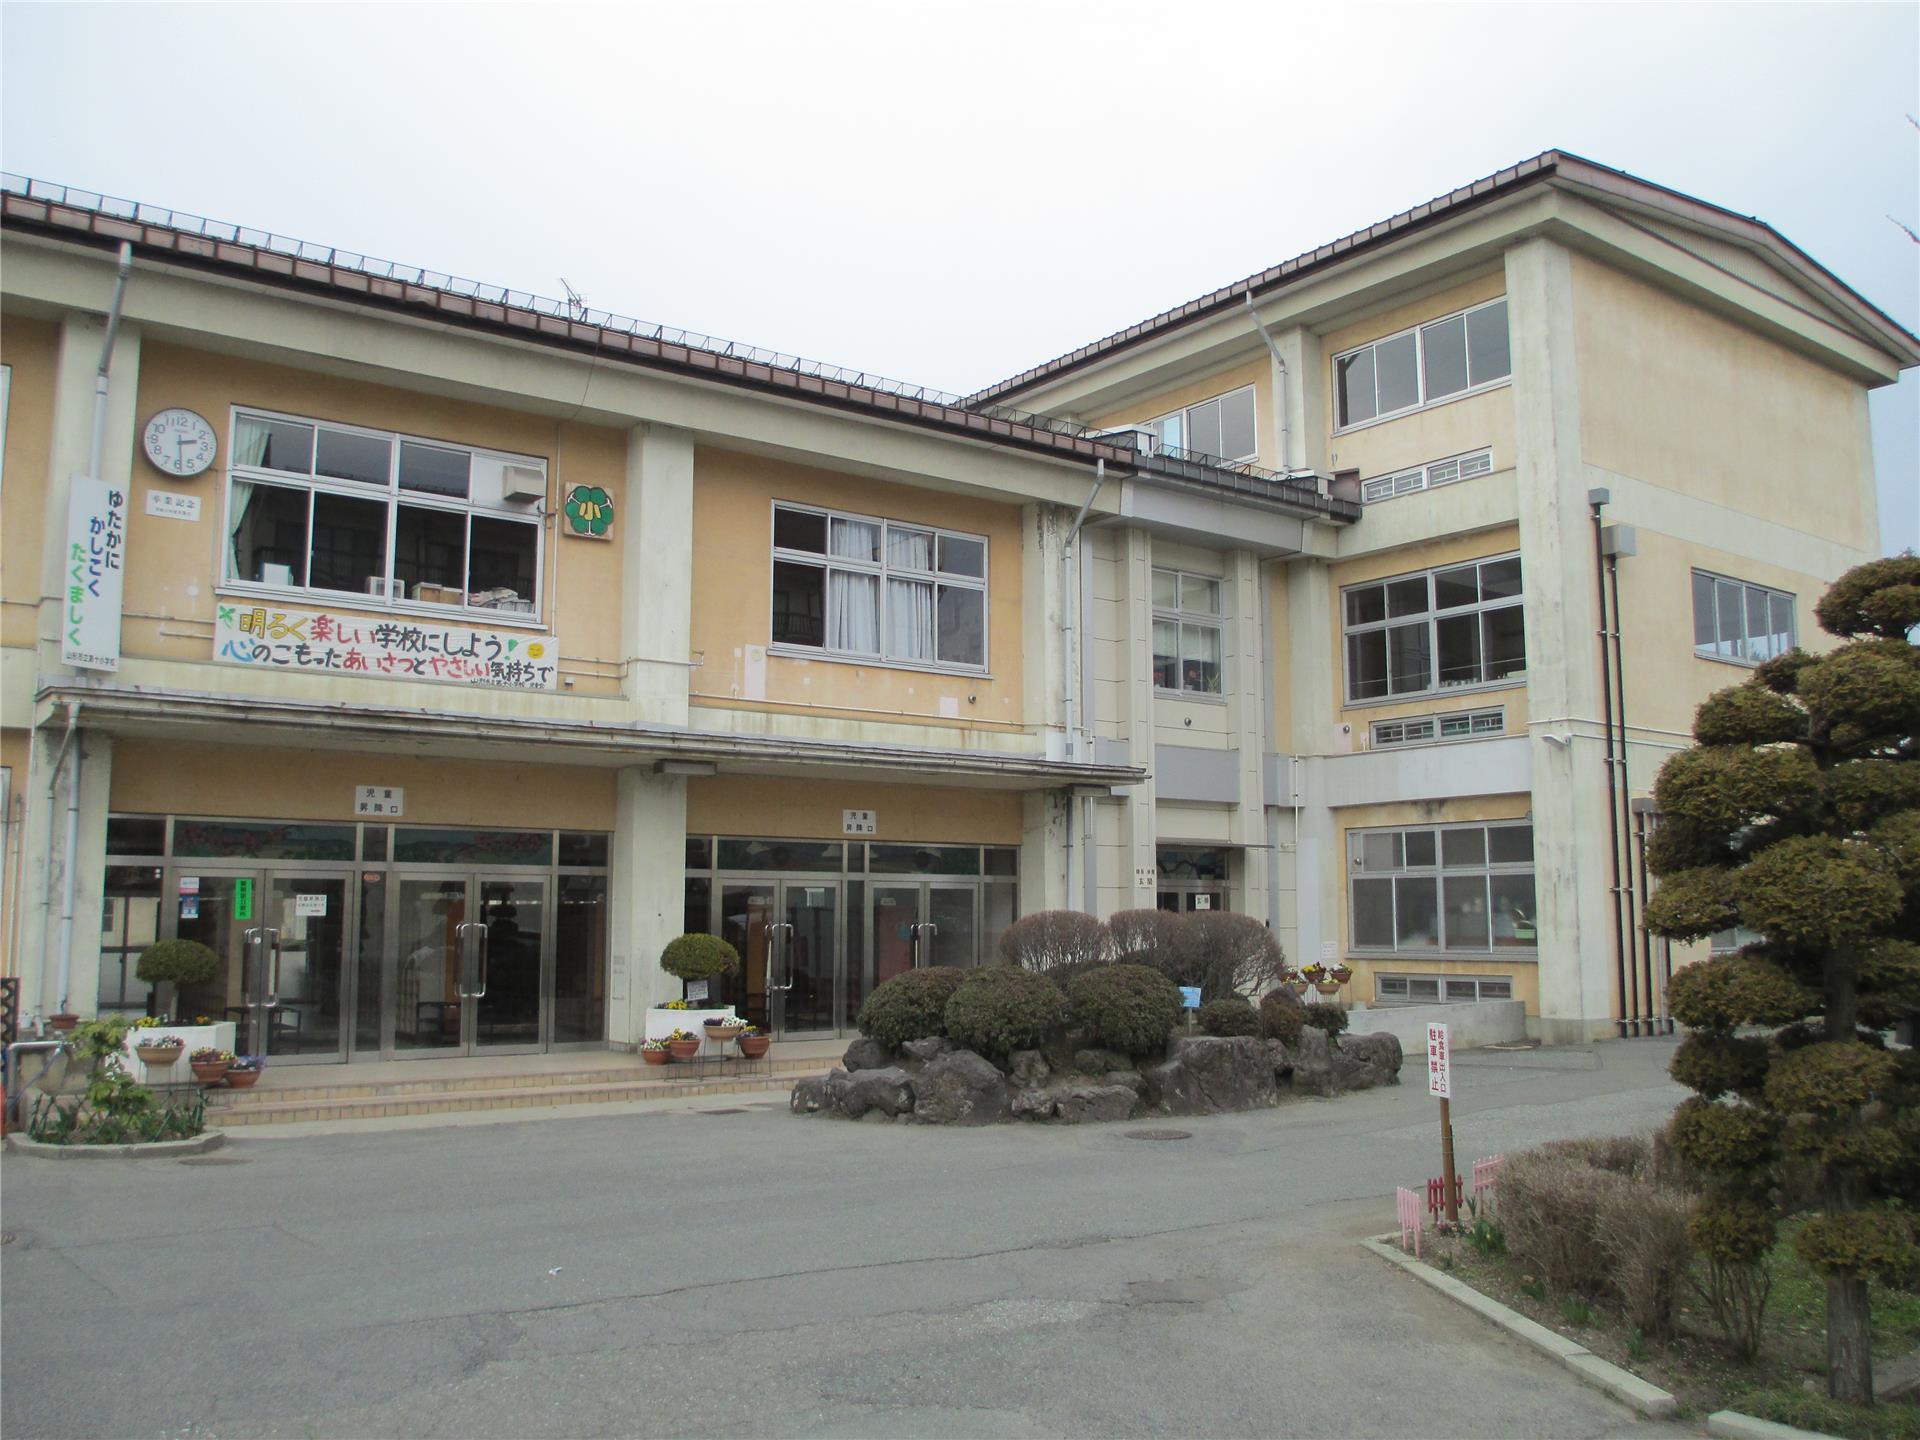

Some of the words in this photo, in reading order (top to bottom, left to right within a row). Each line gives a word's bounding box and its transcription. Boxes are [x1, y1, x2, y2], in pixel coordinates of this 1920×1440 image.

[165, 415, 175, 428] 11
[176, 416, 189, 428] 12
[152, 423, 166, 434] 10
[150, 434, 158, 444] 9
[198, 430, 207, 440] 2
[153, 445, 162, 455] 8
[201, 441, 209, 452] 3
[163, 455, 171, 465] 7
[196, 453, 204, 461] 4
[174, 459, 181, 469] 6
[186, 459, 194, 469] 5
[105, 489, 124, 570] ゆたかに
[88, 516, 106, 598] かしこく
[68, 543, 87, 647] たくましく
[220, 638, 554, 683] 心のこもったあいさつとやさしい気持ちで
[365, 788, 392, 799] 児童
[360, 802, 399, 814] 昇降口
[1429, 1028, 1439, 1091] 駐車禁止
[1437, 1029, 1447, 1093] 給食車出入口
